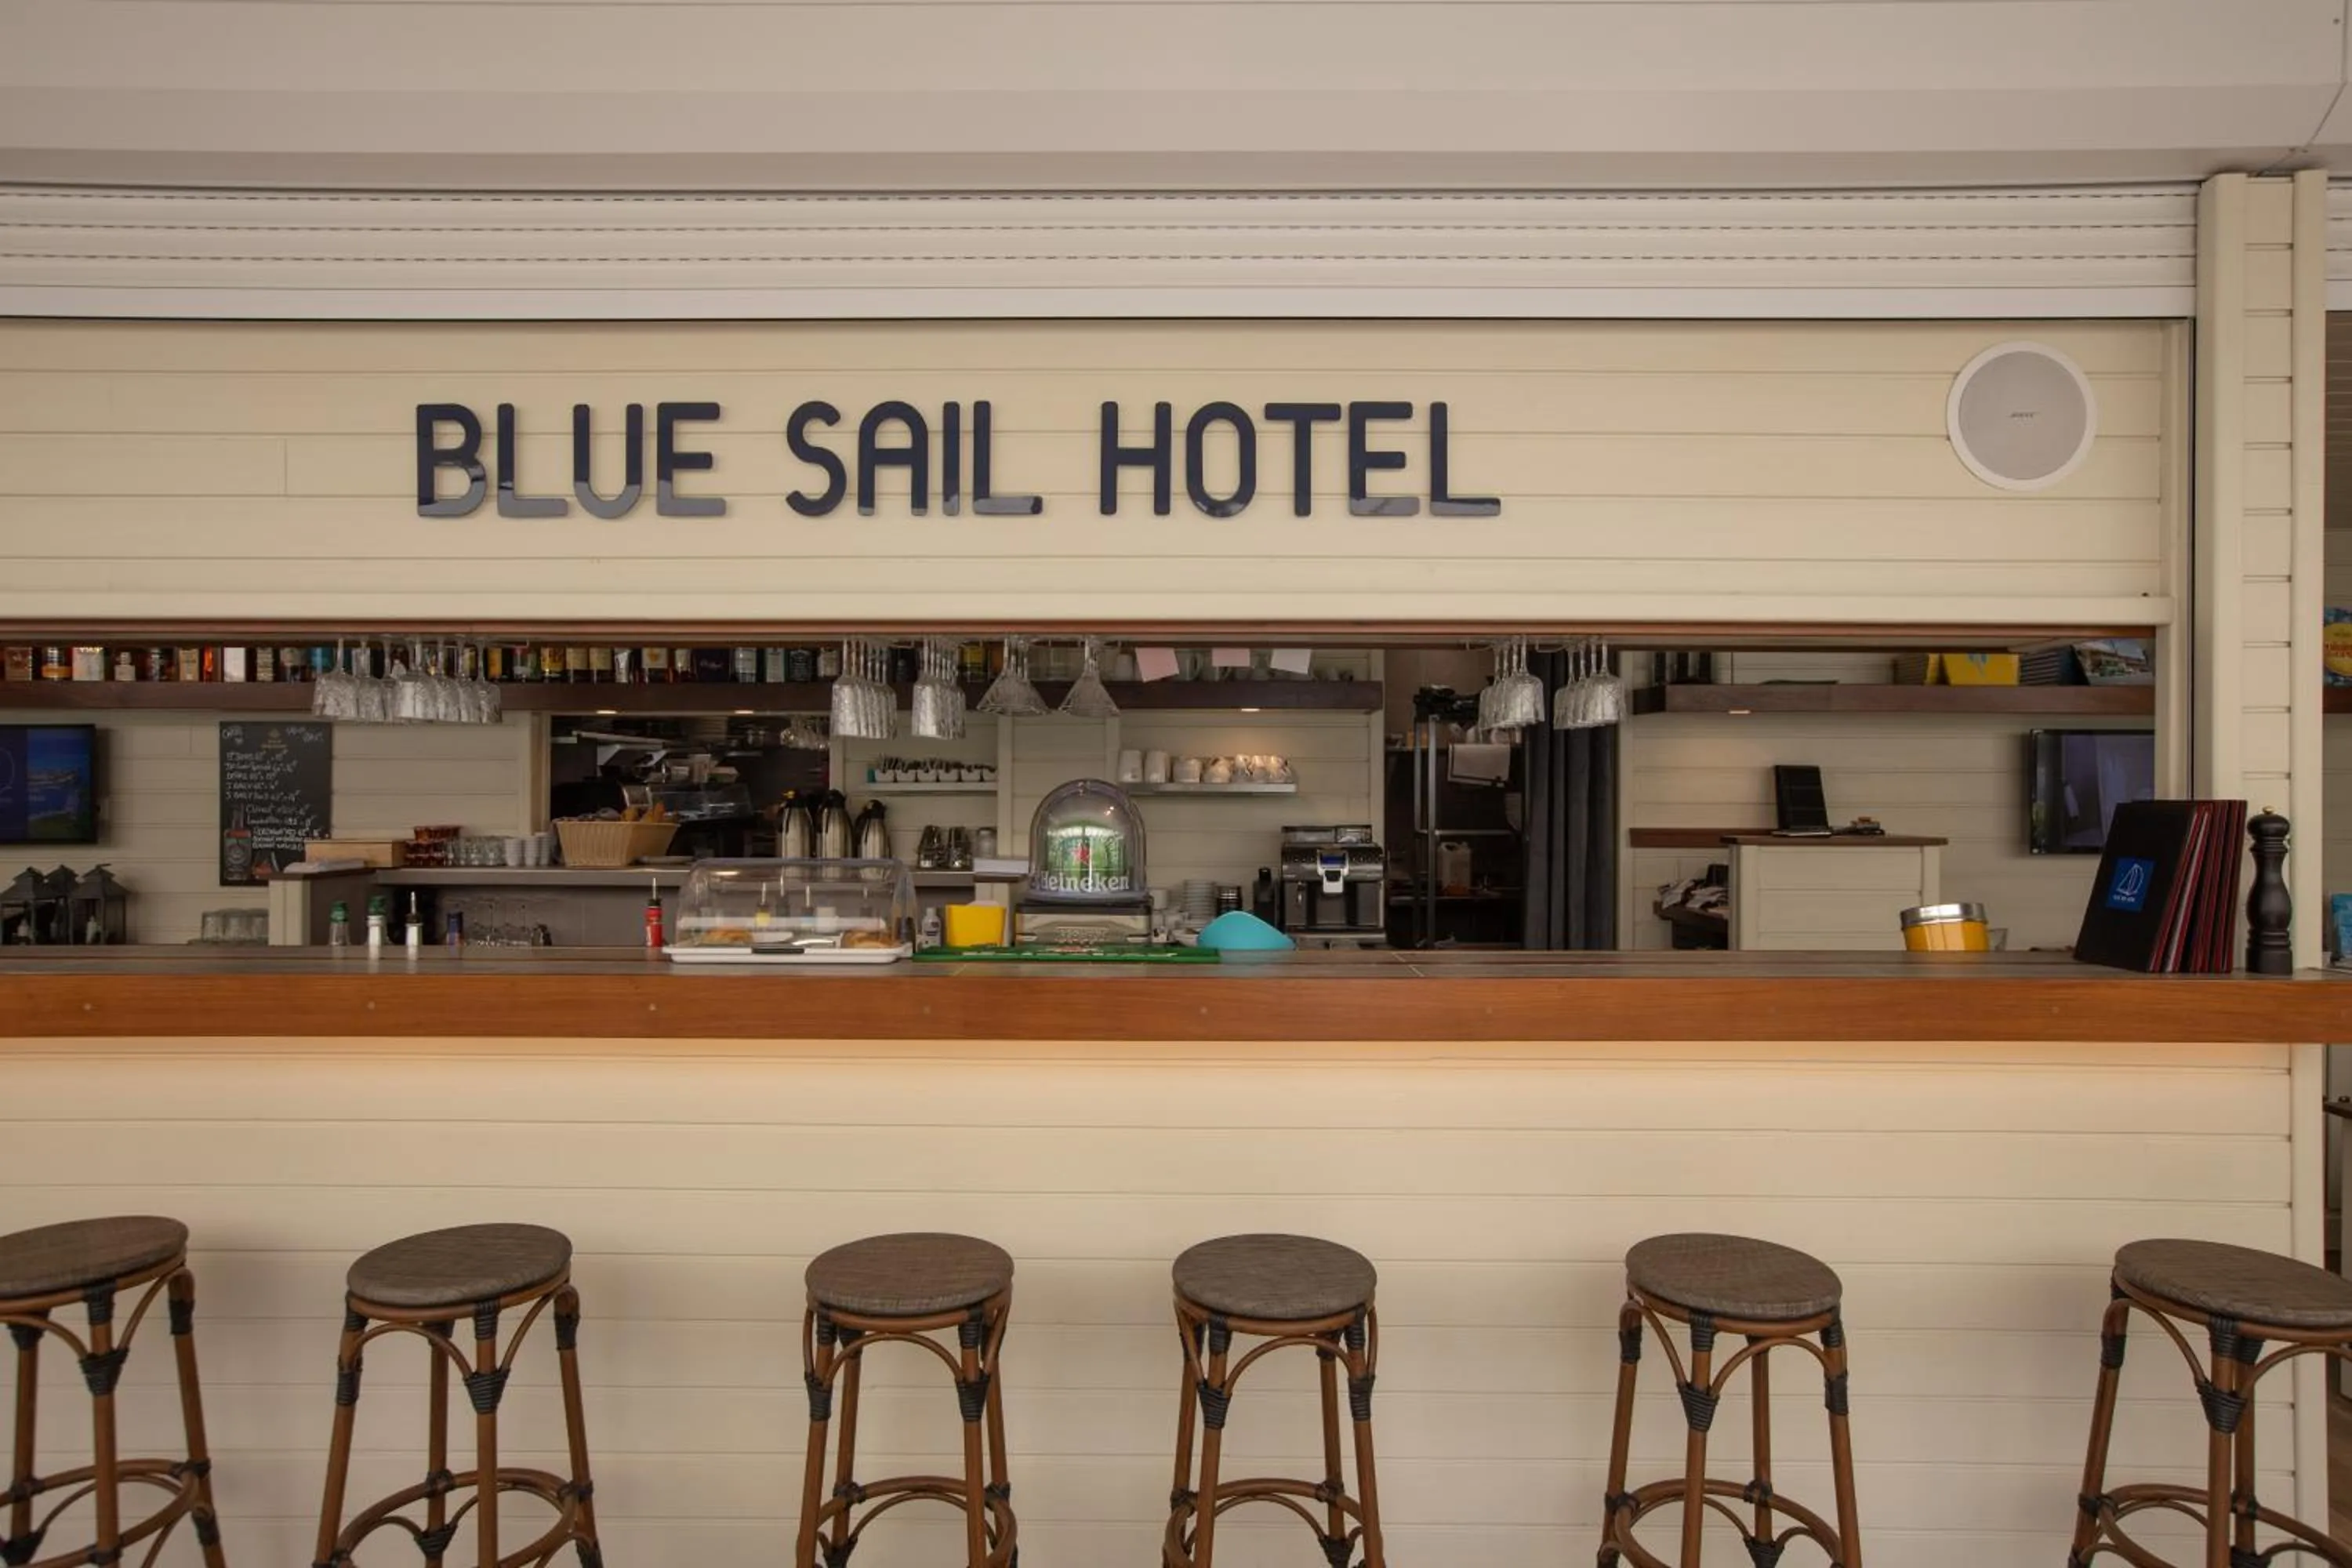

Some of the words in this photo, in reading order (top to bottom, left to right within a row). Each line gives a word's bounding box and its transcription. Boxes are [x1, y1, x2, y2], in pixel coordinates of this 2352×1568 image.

[416, 401, 726, 519] BLUE
[786, 400, 1044, 517] SAIL
[1099, 401, 1501, 519] HOTEL
[1040, 869, 1130, 892] Heineken
